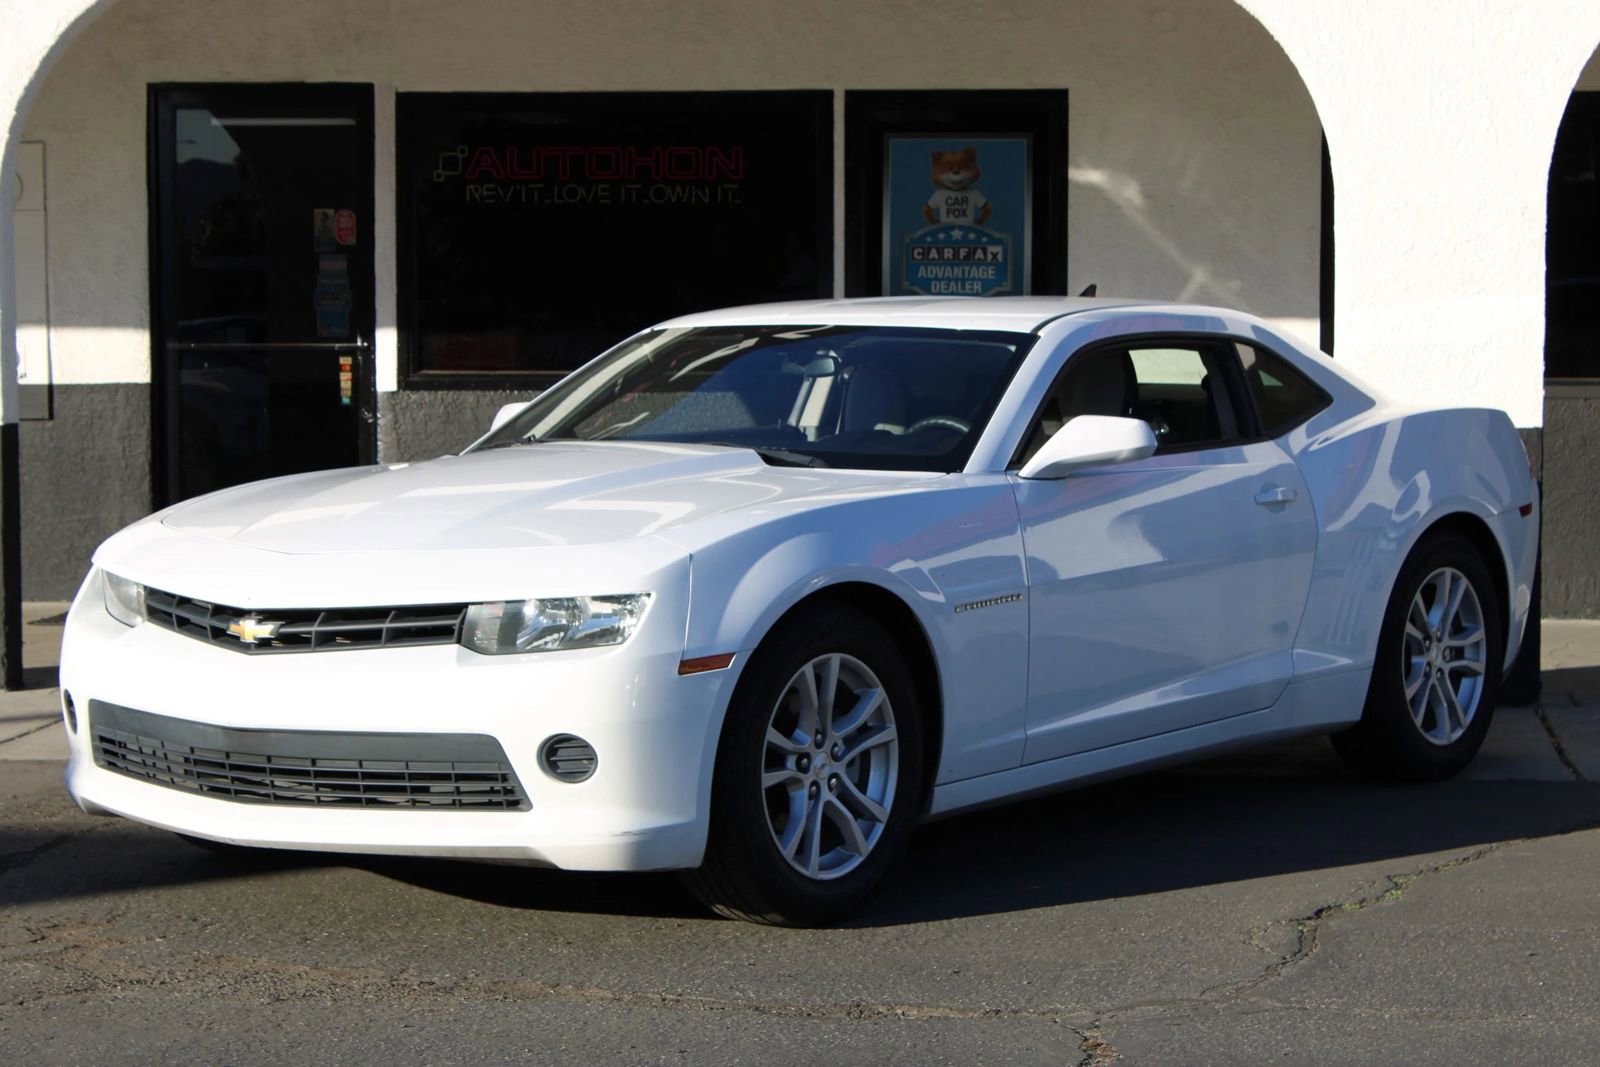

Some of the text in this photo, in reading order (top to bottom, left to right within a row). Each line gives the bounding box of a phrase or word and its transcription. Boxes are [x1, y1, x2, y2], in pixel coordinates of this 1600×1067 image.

[464, 145, 746, 180] AUTOHON
[553, 184, 611, 204] LOVE
[649, 184, 710, 204] OWN
[945, 196, 969, 208] CAR
[946, 207, 969, 219] FOX
[912, 246, 1002, 262] CARFAX
[917, 265, 997, 279] ADVANTAGE
[930, 280, 982, 294] DEALER
